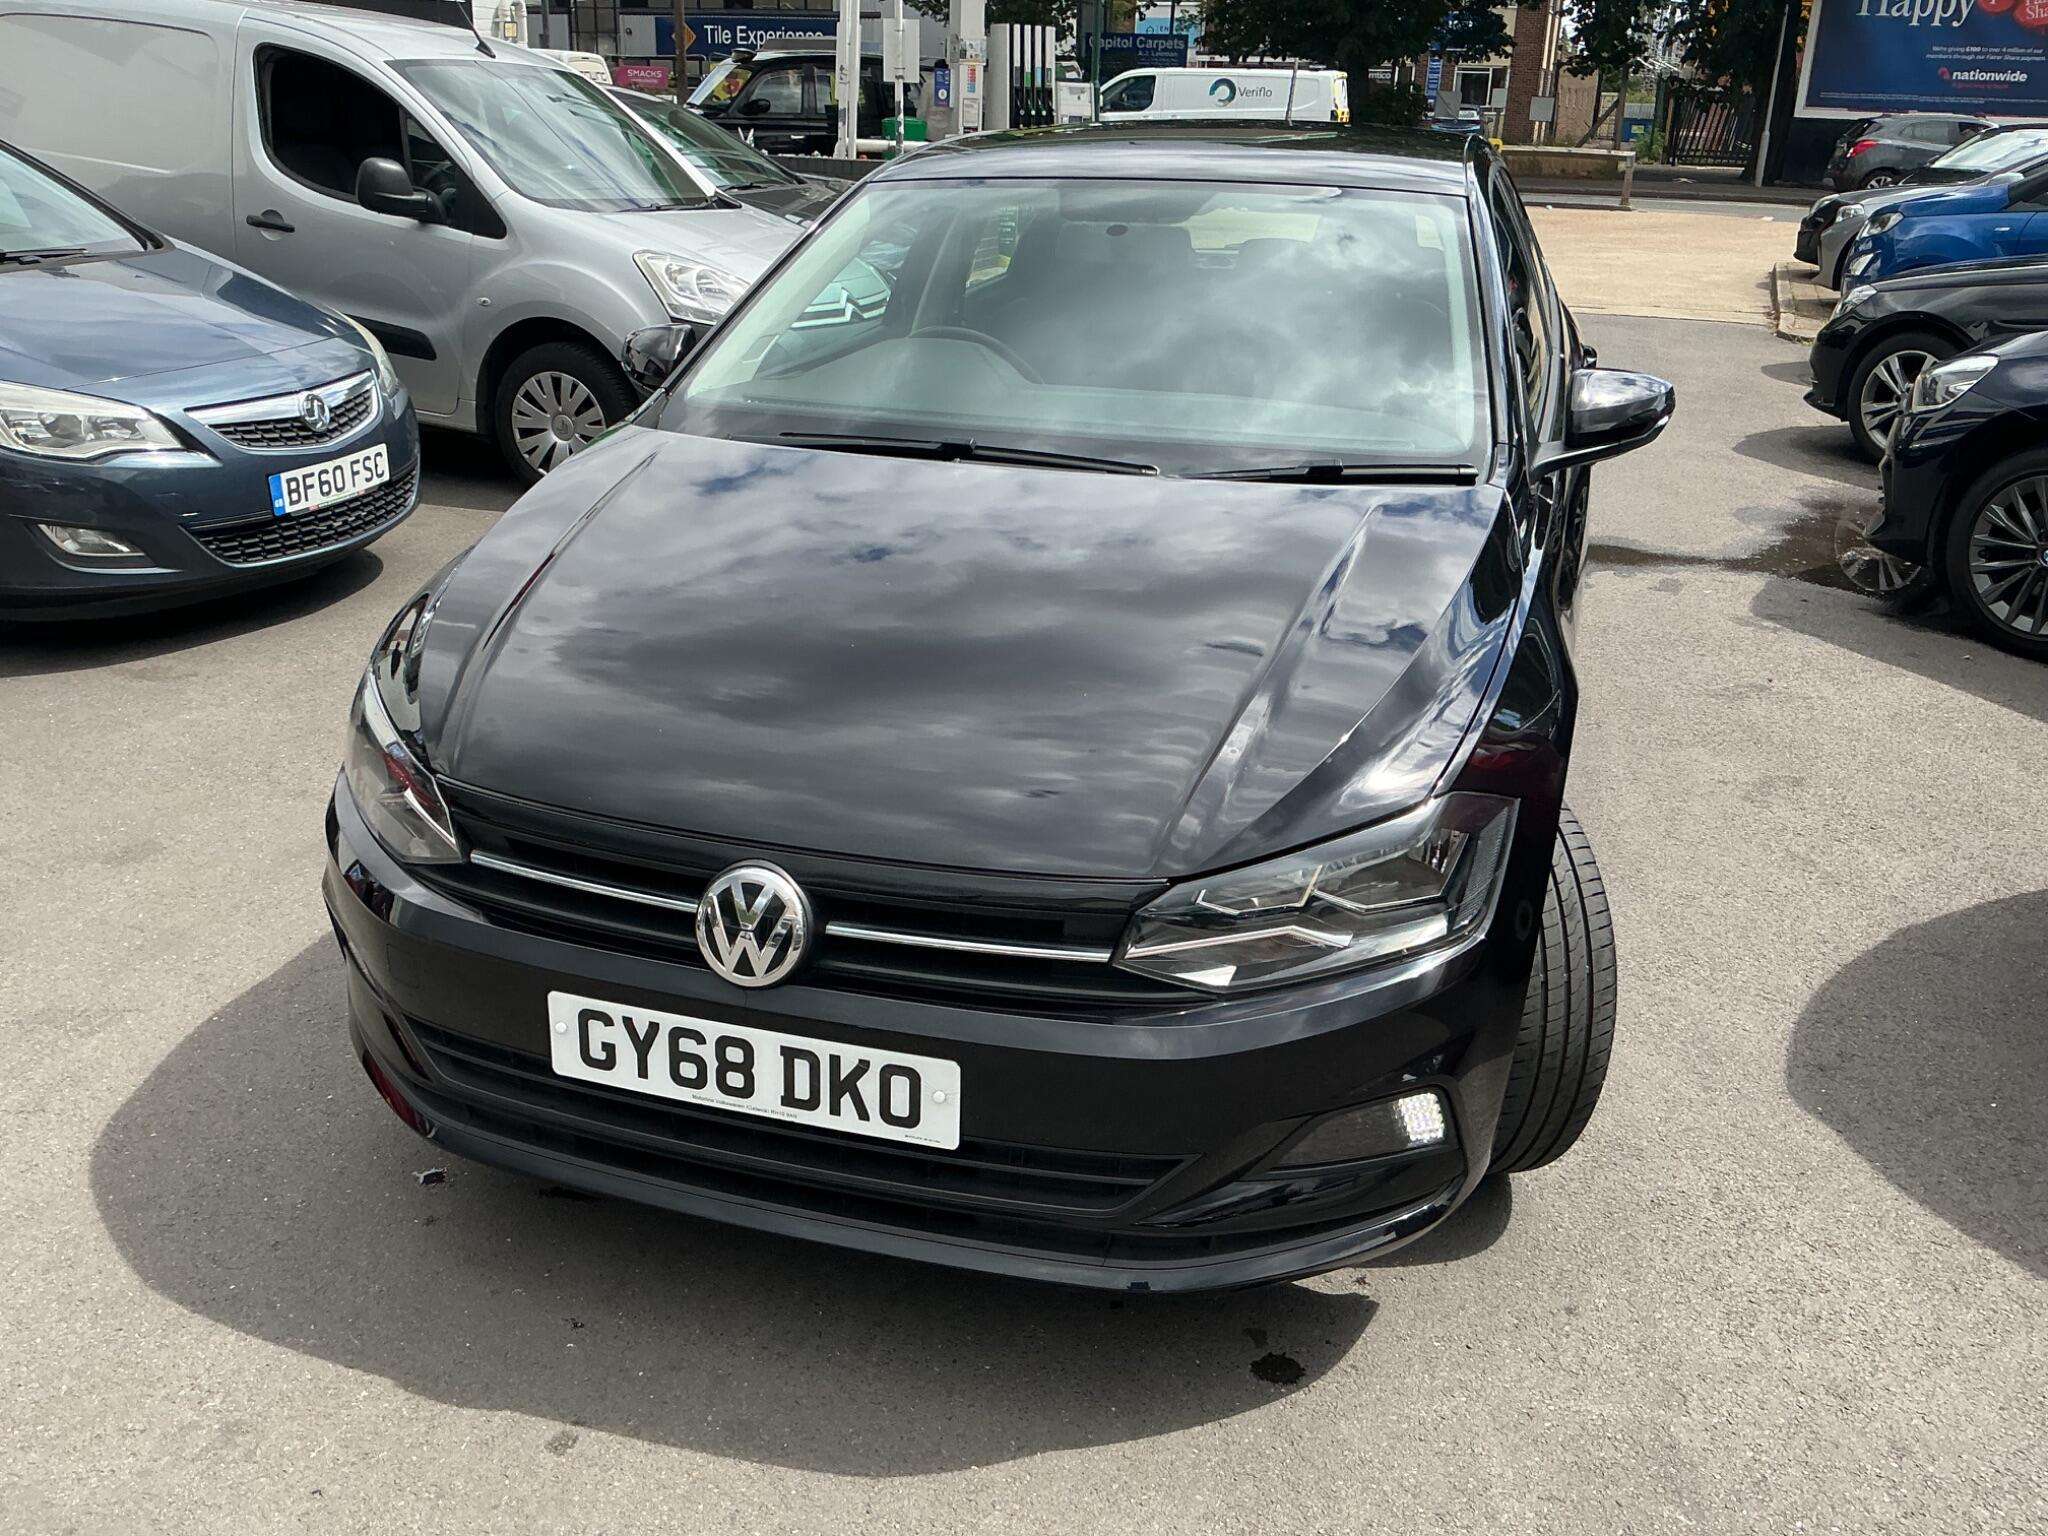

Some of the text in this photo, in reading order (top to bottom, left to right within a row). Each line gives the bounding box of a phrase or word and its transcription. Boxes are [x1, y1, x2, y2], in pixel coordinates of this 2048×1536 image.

[704, 25, 732, 44] Tile
[1136, 36, 1185, 51] Carpets
[627, 69, 662, 78] SMACKS
[1368, 71, 1392, 80] mtico
[1952, 69, 2028, 82] nationwide
[1238, 82, 1273, 98] Veriflo
[286, 465, 346, 506] BF60
[350, 451, 385, 488] FSC
[577, 1007, 922, 1130] GY68 DKO
